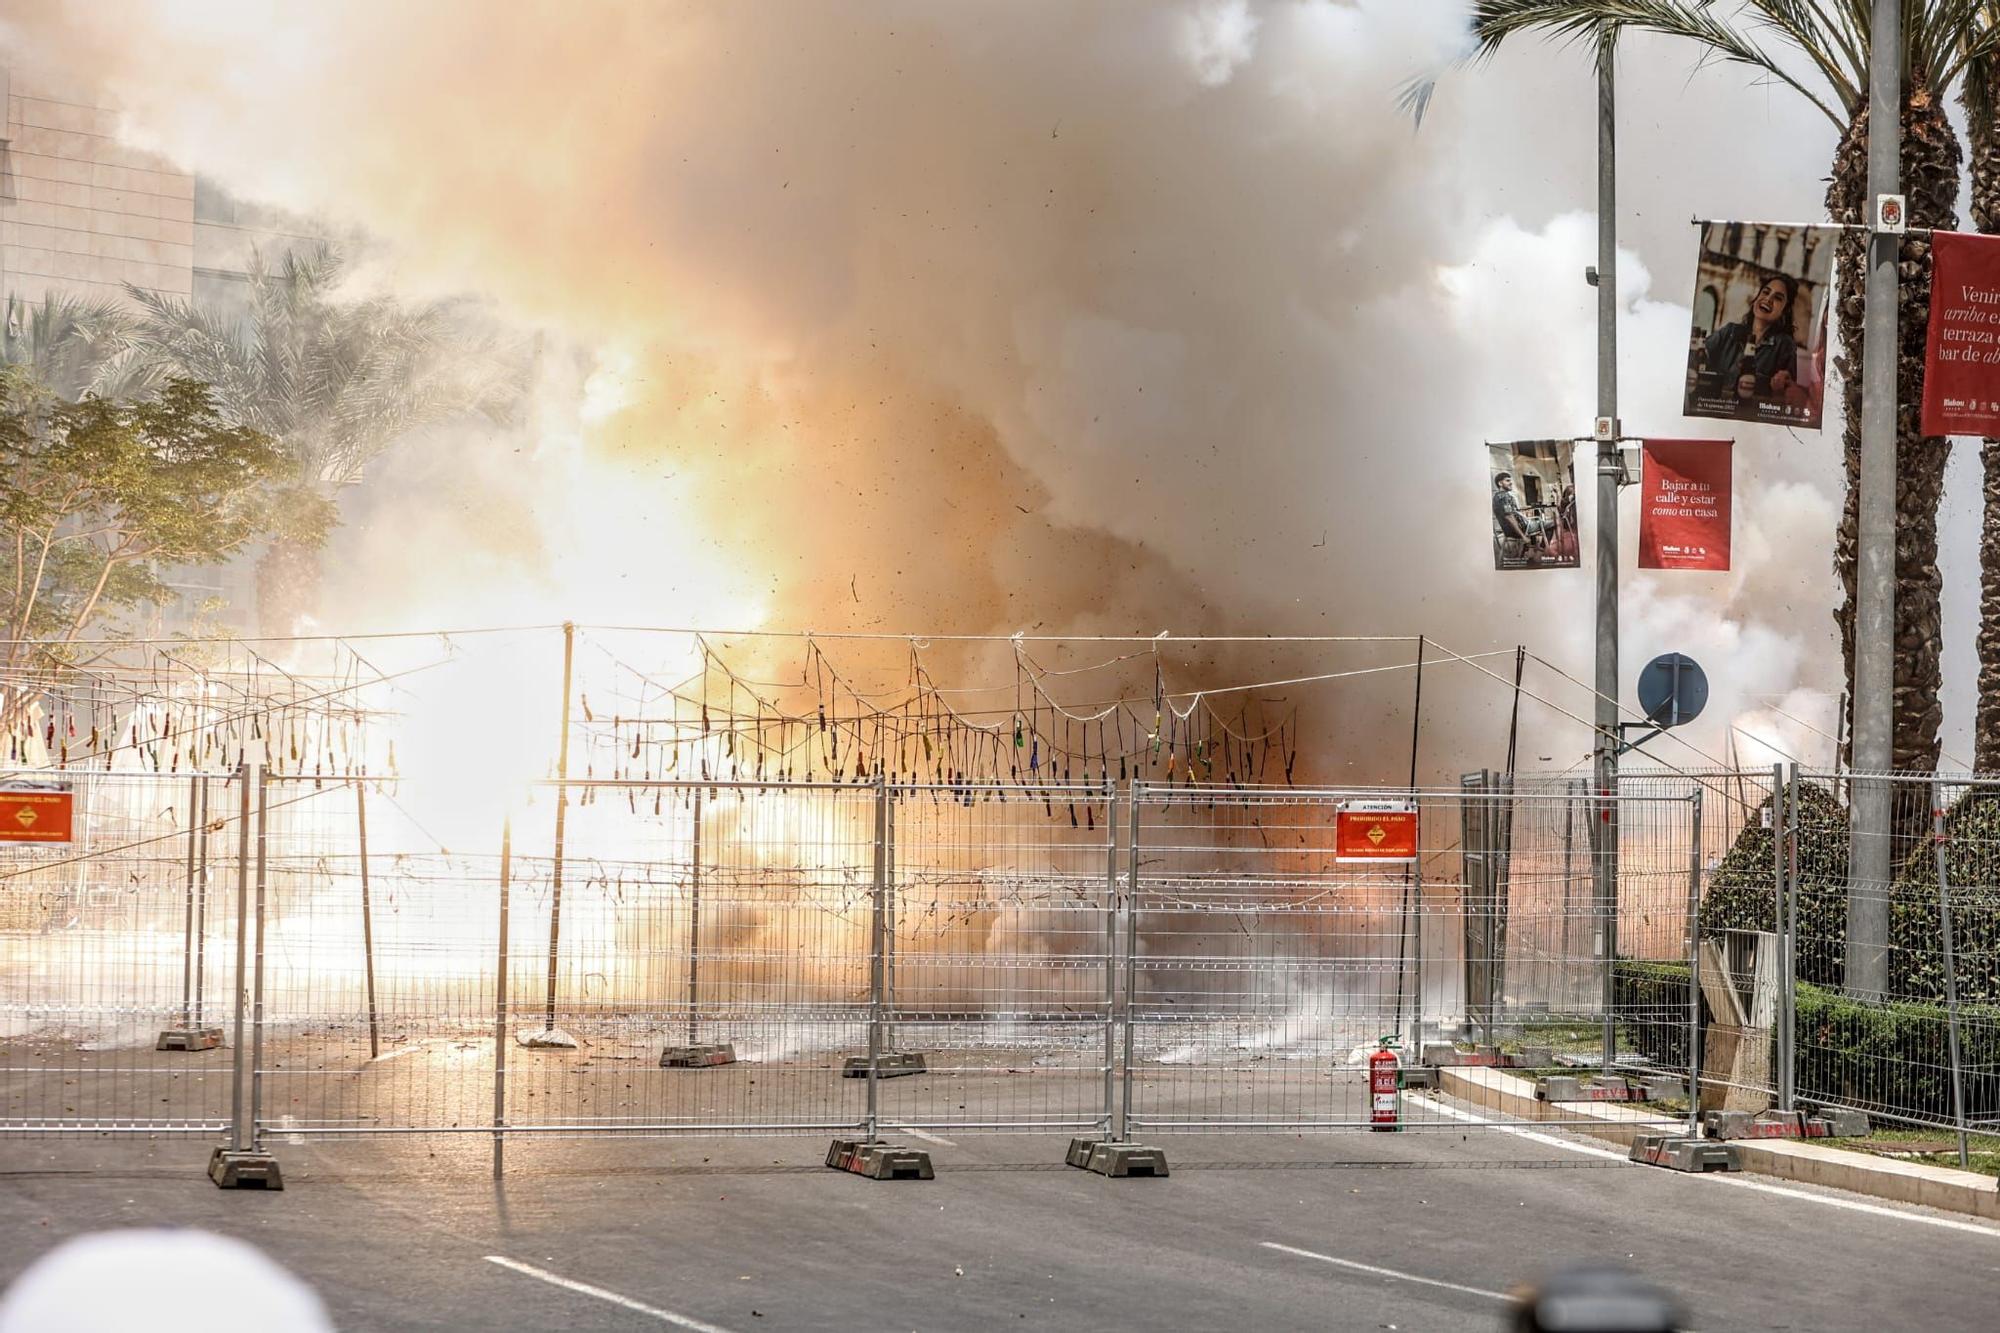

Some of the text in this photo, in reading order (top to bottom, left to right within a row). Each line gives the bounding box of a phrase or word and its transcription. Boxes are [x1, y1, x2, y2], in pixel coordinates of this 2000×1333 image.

[1962, 286, 2000, 304] Venir
[1943, 305, 1986, 323] arriba
[1943, 327, 1993, 343] terraza
[1939, 344, 1959, 360] bar
[1962, 345, 1980, 362] de
[1662, 479, 1689, 493] Bajar
[1699, 482, 1710, 491] tu
[1655, 492, 1716, 506] calle y estar
[1652, 507, 1718, 517] como en casa
